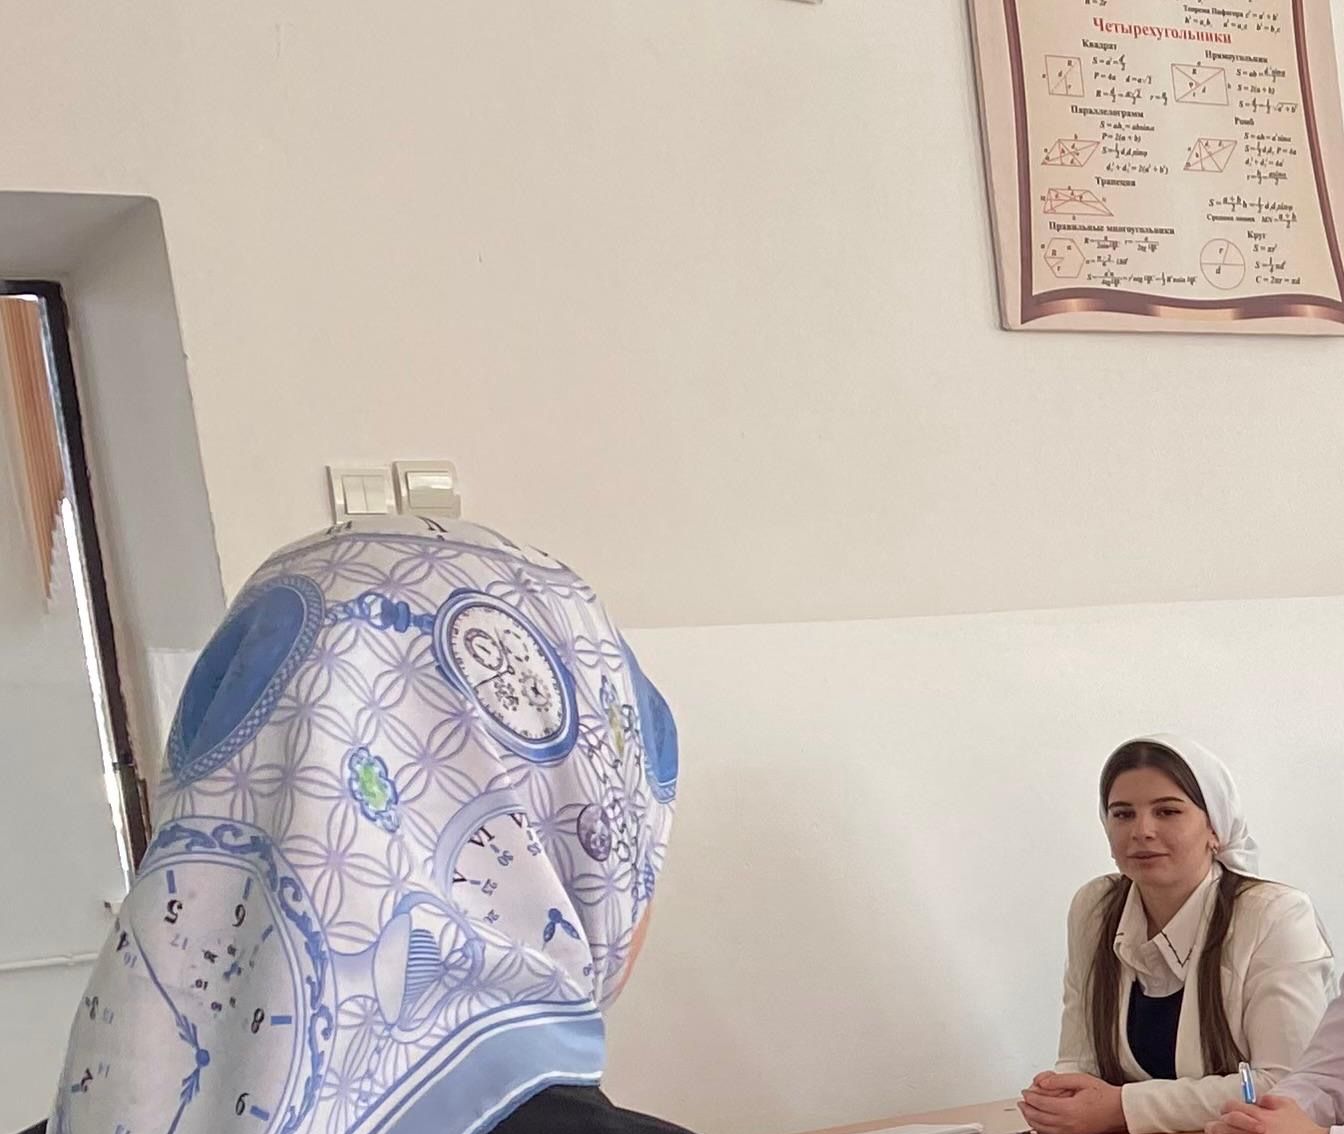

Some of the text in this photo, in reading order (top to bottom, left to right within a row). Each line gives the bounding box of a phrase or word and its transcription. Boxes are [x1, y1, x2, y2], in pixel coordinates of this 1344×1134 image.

[1093, 17, 1232, 44] Четырехугольники
[1071, 105, 1144, 119] Параллелограмм
[1049, 221, 1175, 236] Правильные многоугольники
[1247, 230, 1266, 241] Круг
